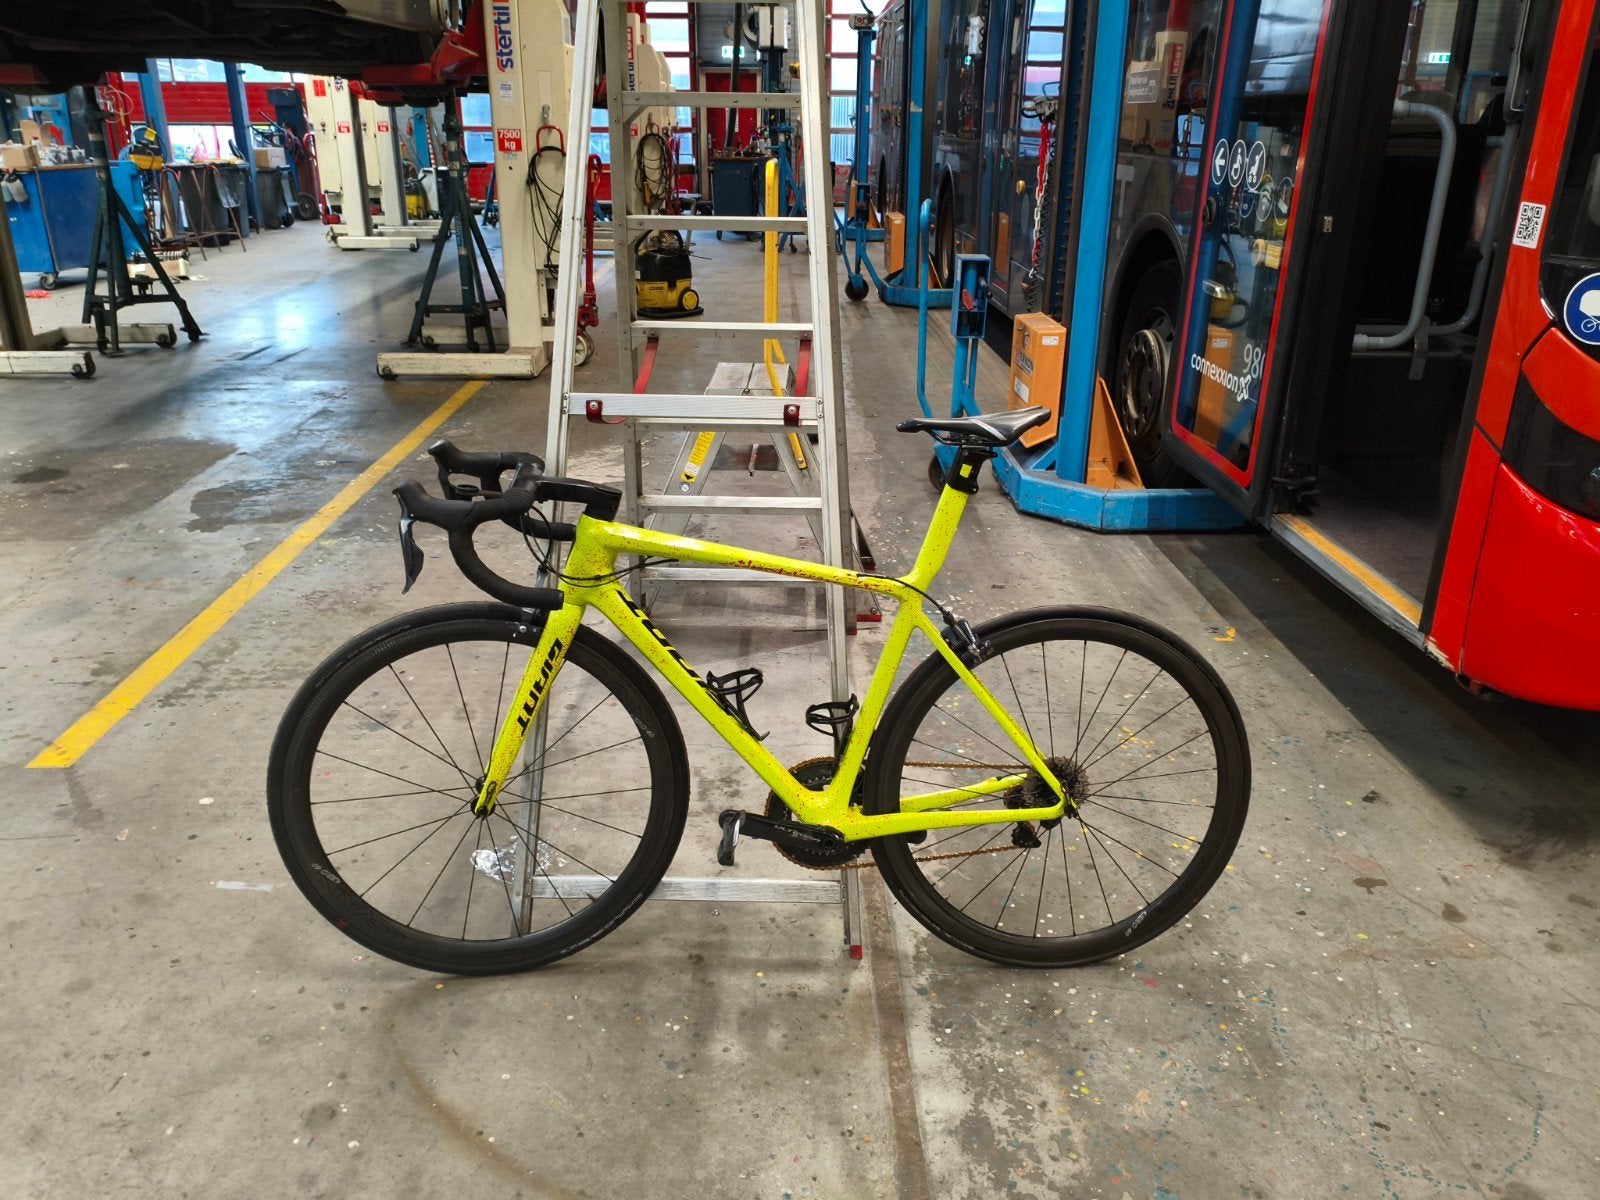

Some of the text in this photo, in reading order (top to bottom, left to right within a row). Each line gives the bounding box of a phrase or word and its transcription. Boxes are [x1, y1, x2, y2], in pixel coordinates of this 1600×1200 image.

[493, 6, 513, 70] stertil
[499, 129, 520, 138] 7500
[504, 140, 516, 151] kg
[1191, 354, 1238, 393] connexxion
[517, 637, 563, 737] GIANT
